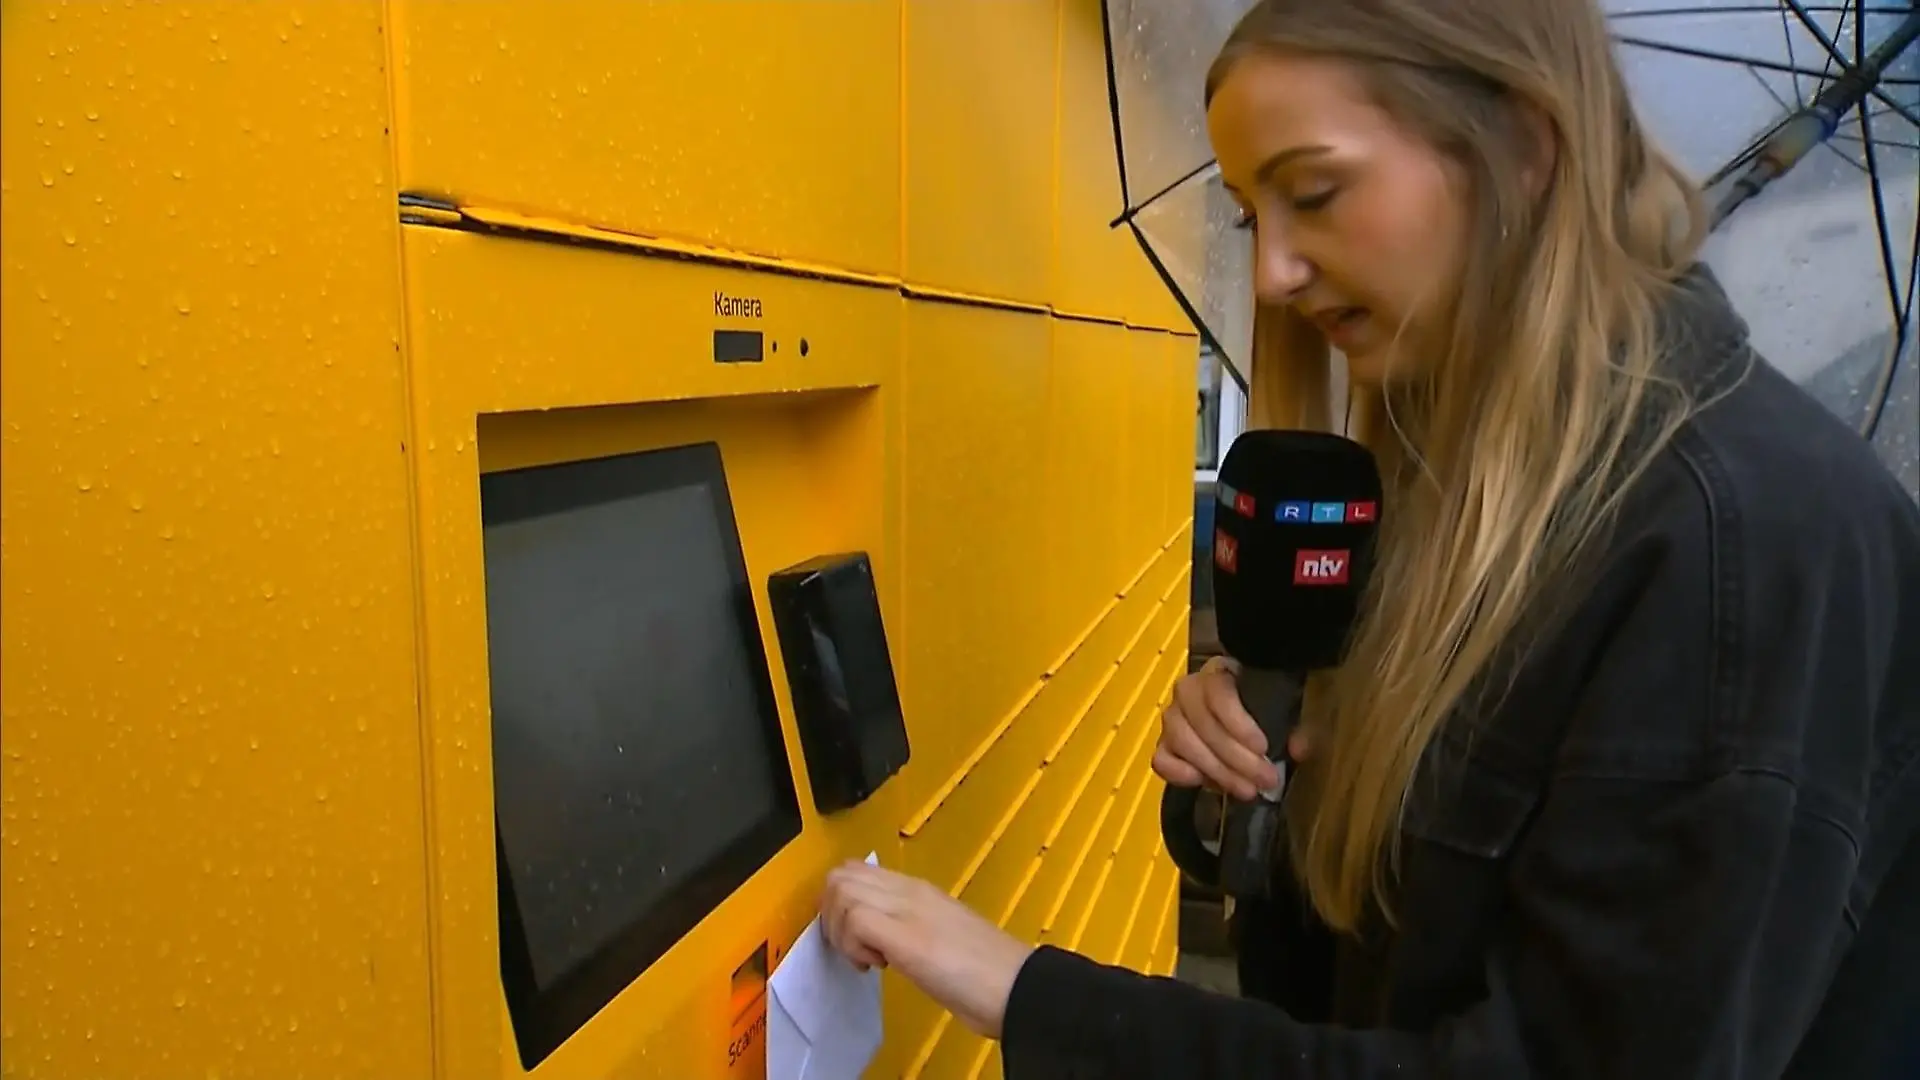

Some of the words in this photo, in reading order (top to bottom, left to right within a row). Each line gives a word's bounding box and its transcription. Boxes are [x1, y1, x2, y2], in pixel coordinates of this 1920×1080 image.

[713, 291, 763, 318] Kamera
[1282, 504, 1369, 521] RTL
[1301, 554, 1344, 578] ntv
